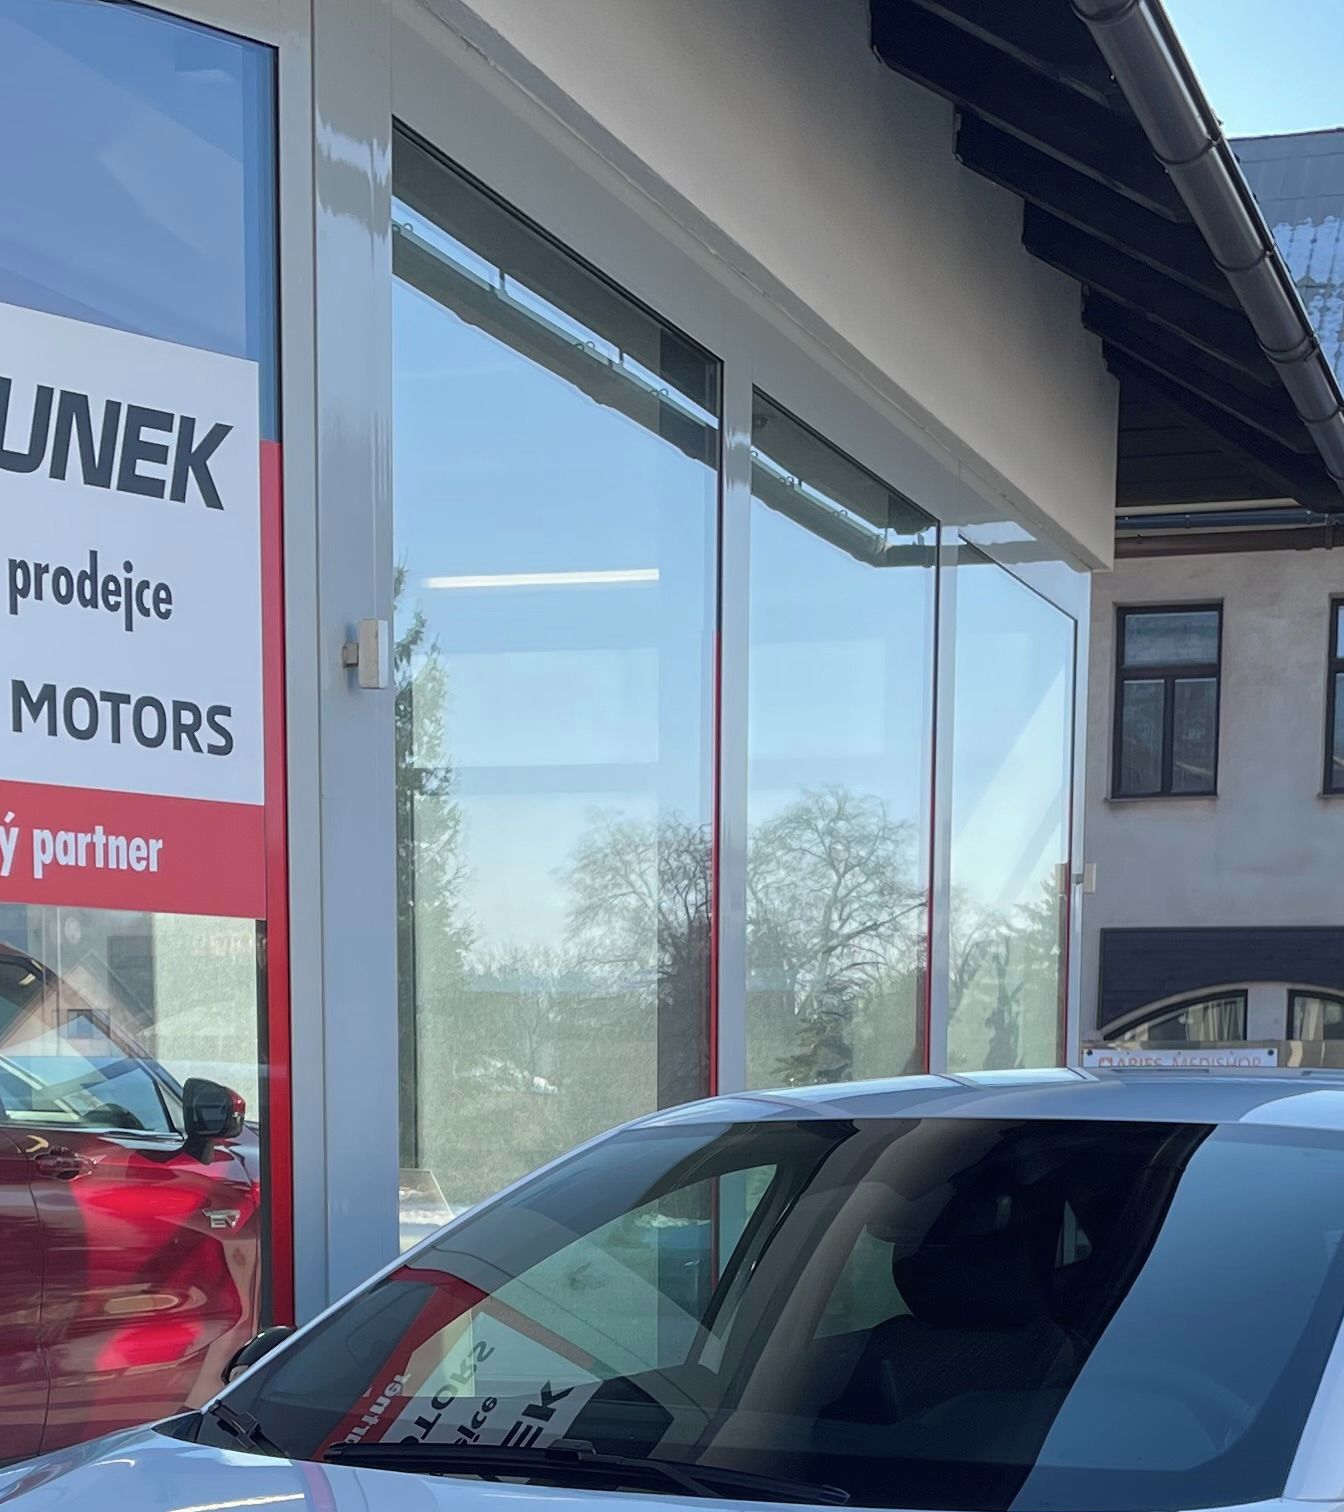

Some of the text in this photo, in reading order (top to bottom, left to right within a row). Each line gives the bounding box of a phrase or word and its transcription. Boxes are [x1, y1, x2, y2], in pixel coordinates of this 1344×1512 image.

[7, 543, 173, 633] prodejce
[11, 679, 234, 757] MOTORS
[32, 824, 163, 879] partner
